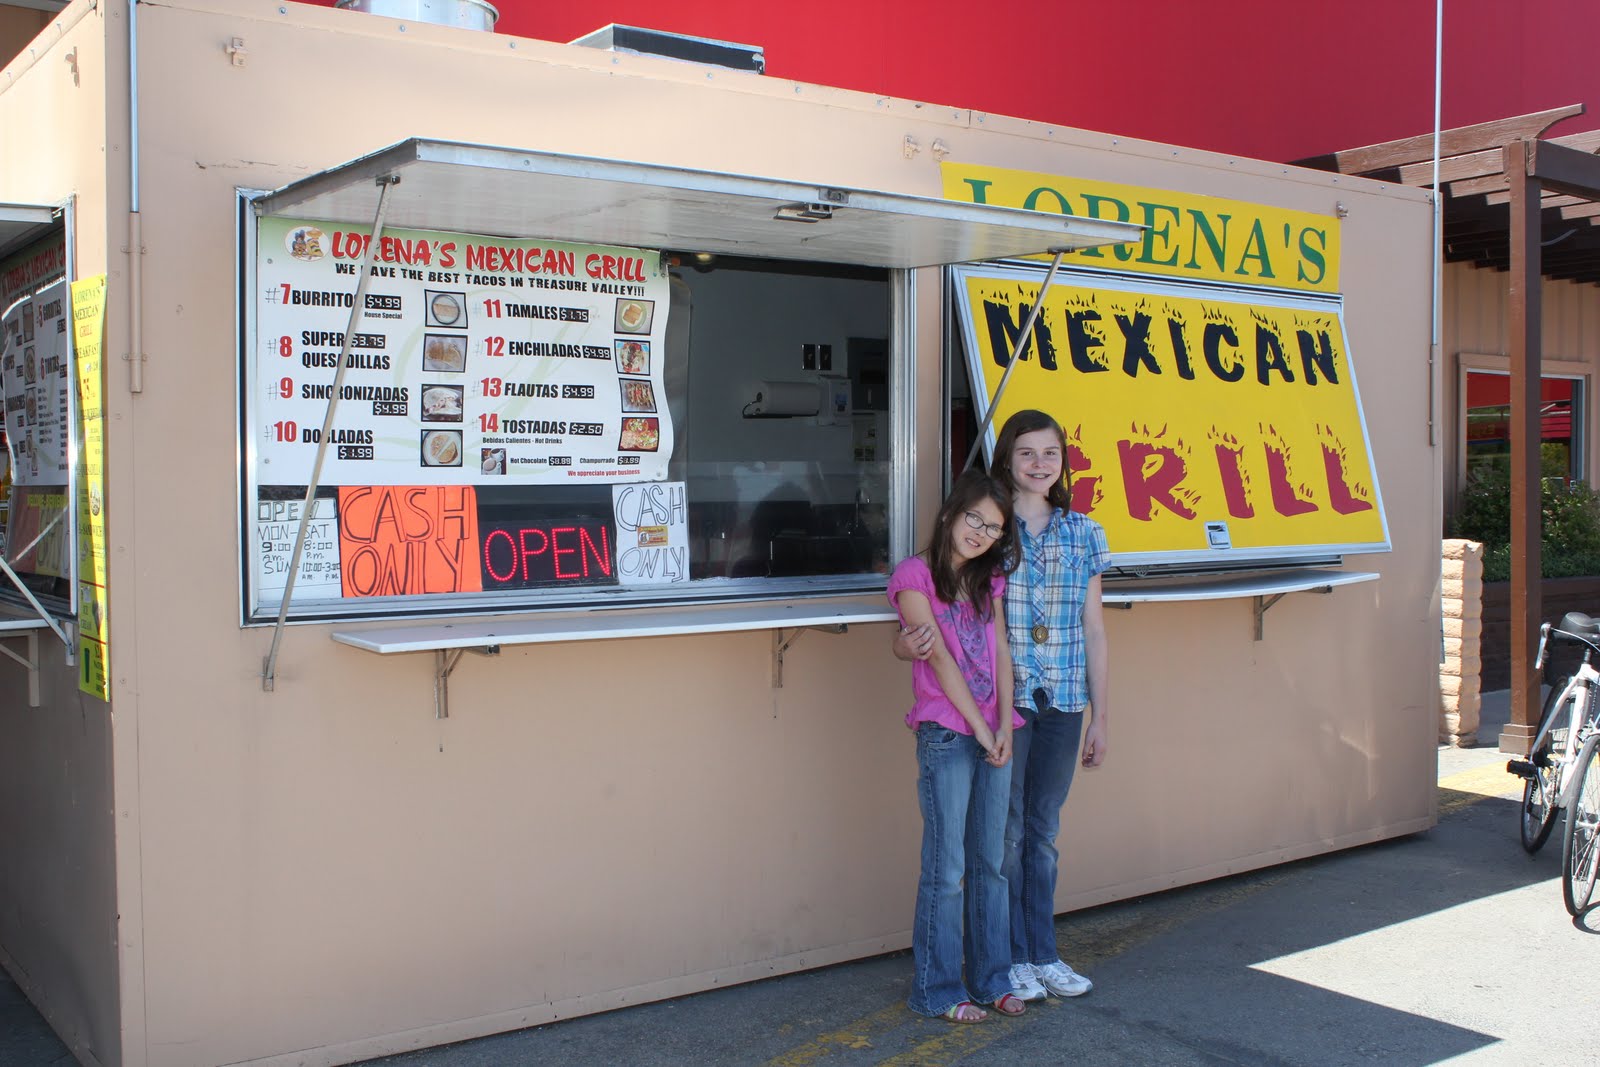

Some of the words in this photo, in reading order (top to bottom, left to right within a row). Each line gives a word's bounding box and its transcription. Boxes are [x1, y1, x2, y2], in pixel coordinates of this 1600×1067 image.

[466, 244, 576, 277] MEXICAN
[585, 253, 647, 283] GRILL
[335, 263, 356, 275] WE
[360, 266, 396, 278] AVE
[401, 269, 423, 281] THE
[428, 271, 460, 284] BEST
[465, 274, 506, 287] TACOS
[511, 277, 524, 287] IN
[528, 278, 587, 292] TREASURE
[592, 283, 645, 297] VALLEY!!!
[292, 289, 356, 308] BURRITO
[367, 296, 401, 310] $4.99
[382, 313, 402, 321] Special
[505, 303, 557, 320] TAMALES
[302, 331, 345, 347] SUPER
[981, 284, 1339, 386] MEXICAN
[509, 341, 581, 359] ENCHILADAS
[584, 345, 611, 360] $4.99
[504, 382, 558, 398] FLAUTAS
[563, 384, 594, 399] $4.99
[374, 402, 407, 415] $4.99
[502, 419, 566, 434] TOSTADAS
[570, 423, 602, 436] $2.50
[339, 446, 373, 459] $1.99
[577, 470, 605, 478] appreciate
[341, 486, 470, 544] CASH
[615, 485, 684, 532] CASH
[484, 526, 610, 582] OPEN
[347, 538, 465, 597] ONLY
[619, 547, 684, 583] ONLY
